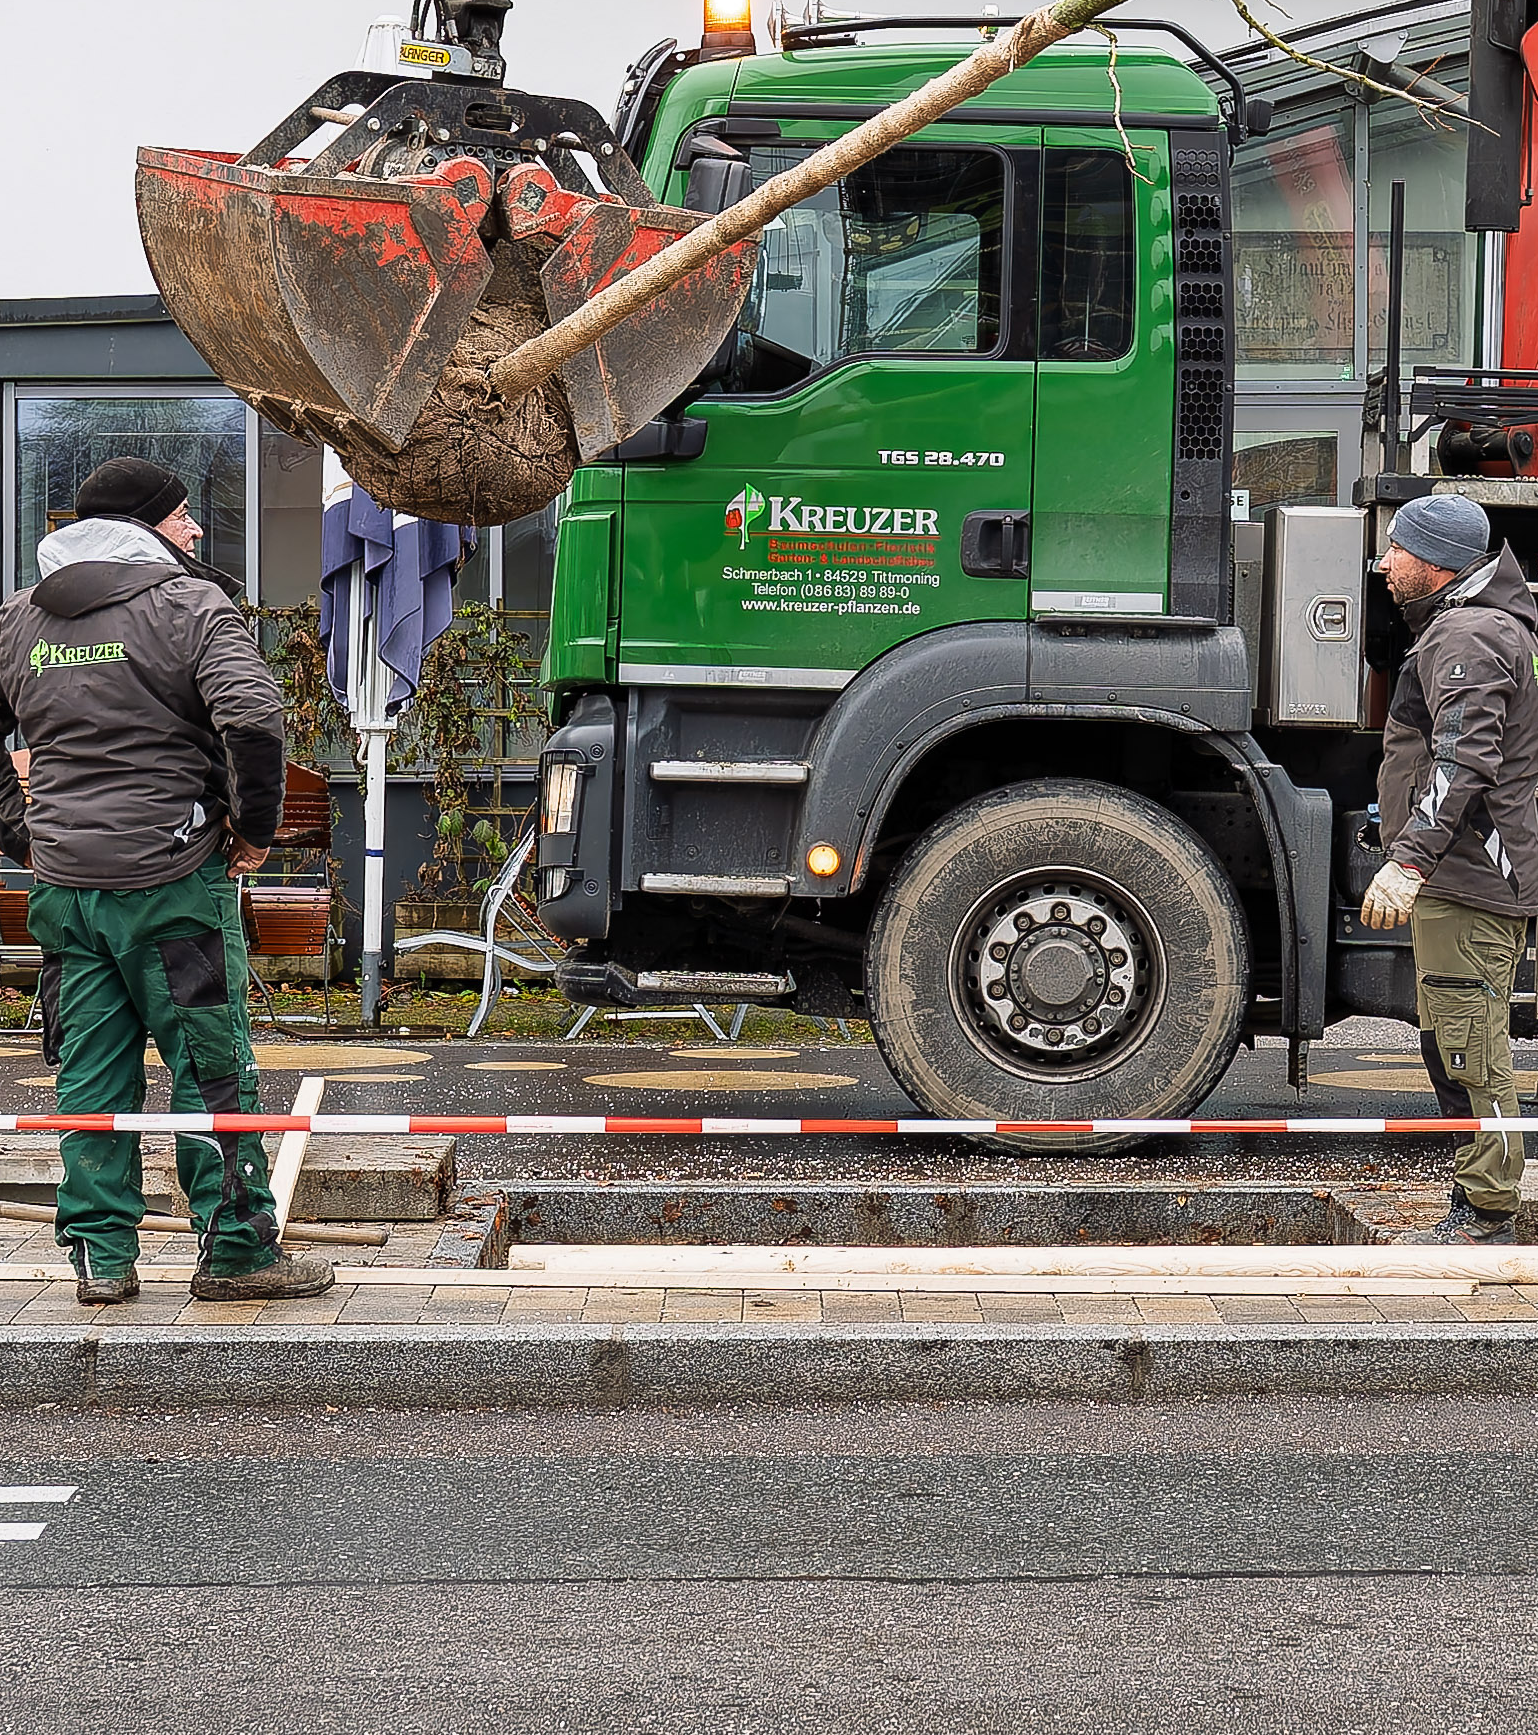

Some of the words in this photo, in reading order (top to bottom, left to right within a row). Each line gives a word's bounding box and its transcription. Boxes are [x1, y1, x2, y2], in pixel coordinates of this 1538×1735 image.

[878, 450, 919, 465] TGS
[925, 451, 1005, 466] 28.470
[767, 496, 940, 535] KREUZER
[722, 566, 803, 582] Schmerbach
[805, 569, 813, 582] 1
[823, 570, 867, 583] 84529
[871, 570, 940, 588] Tittmoning
[751, 582, 797, 596] Telefon
[741, 599, 921, 616] www.kreuzer-pflanzen.de
[48, 642, 126, 664] KREUZER
